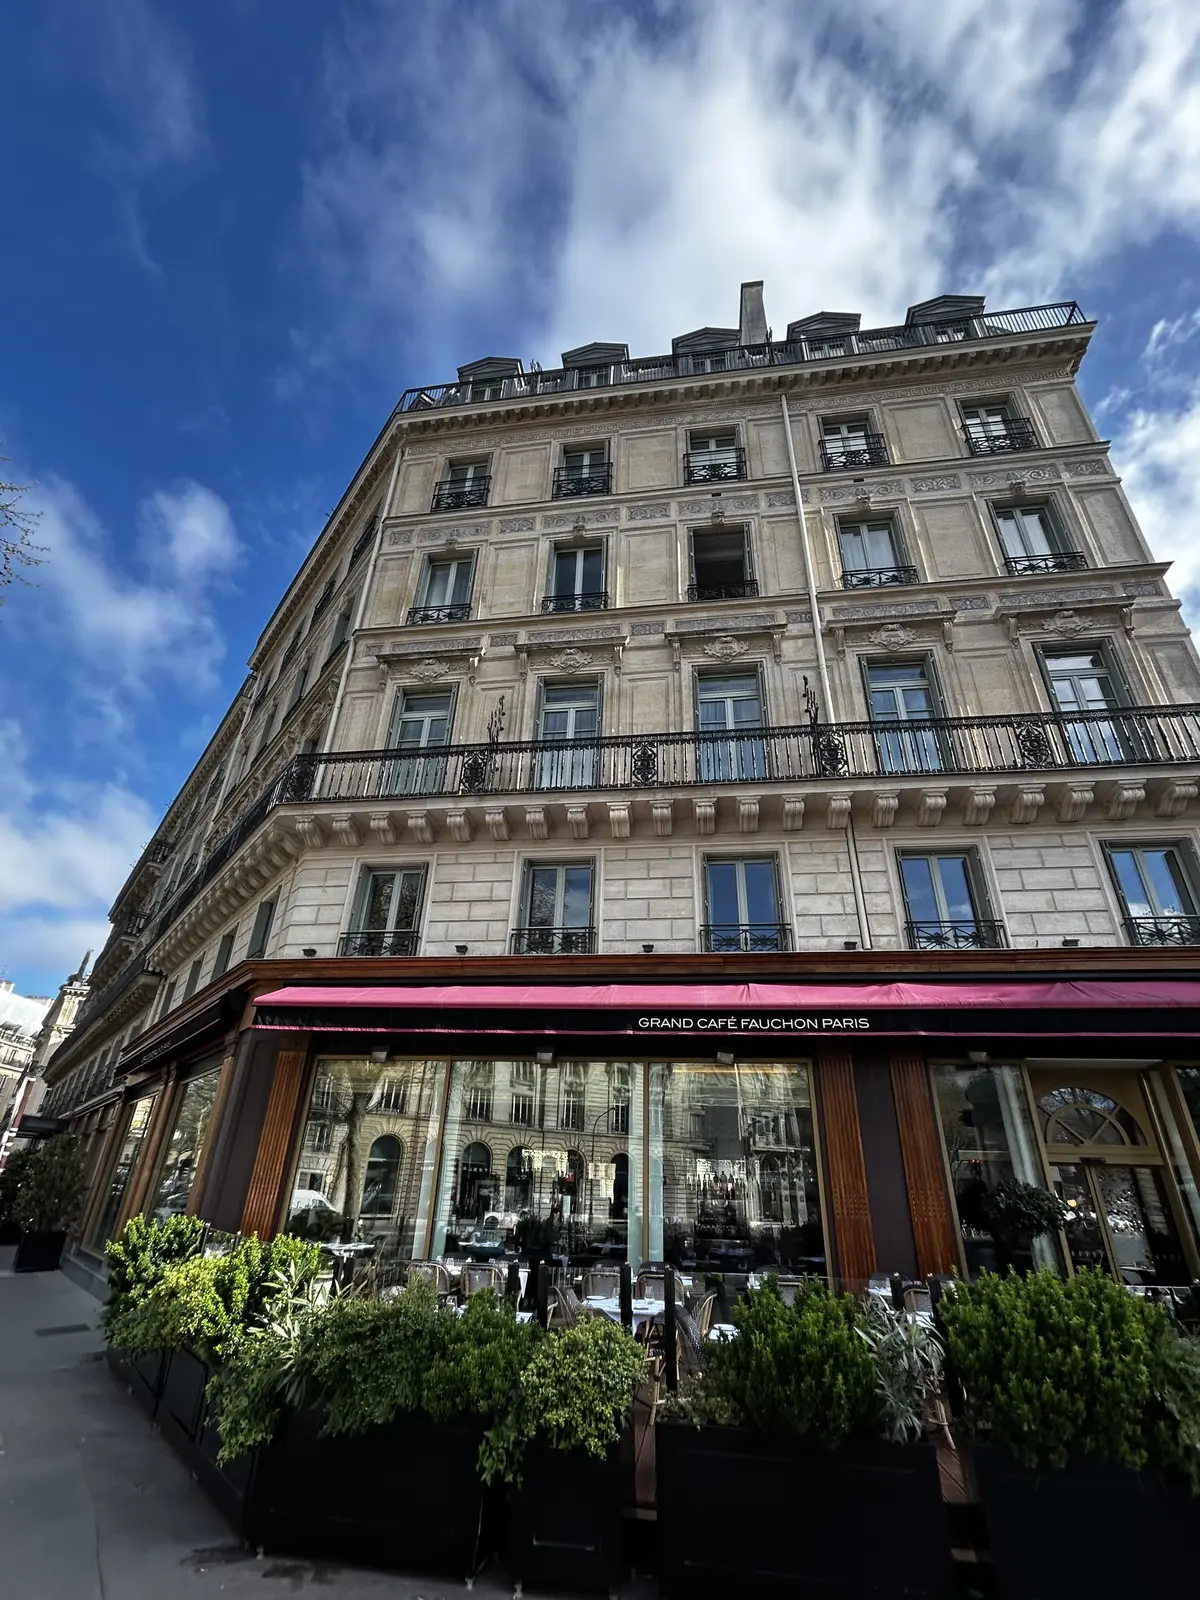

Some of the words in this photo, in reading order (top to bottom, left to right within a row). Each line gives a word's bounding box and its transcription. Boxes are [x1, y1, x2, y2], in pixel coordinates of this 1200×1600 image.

[638, 1017, 694, 1029] GRAND
[696, 1015, 738, 1029] CAFÉ
[740, 1018, 819, 1030] FAUCHON
[821, 1018, 870, 1029] PARIS
